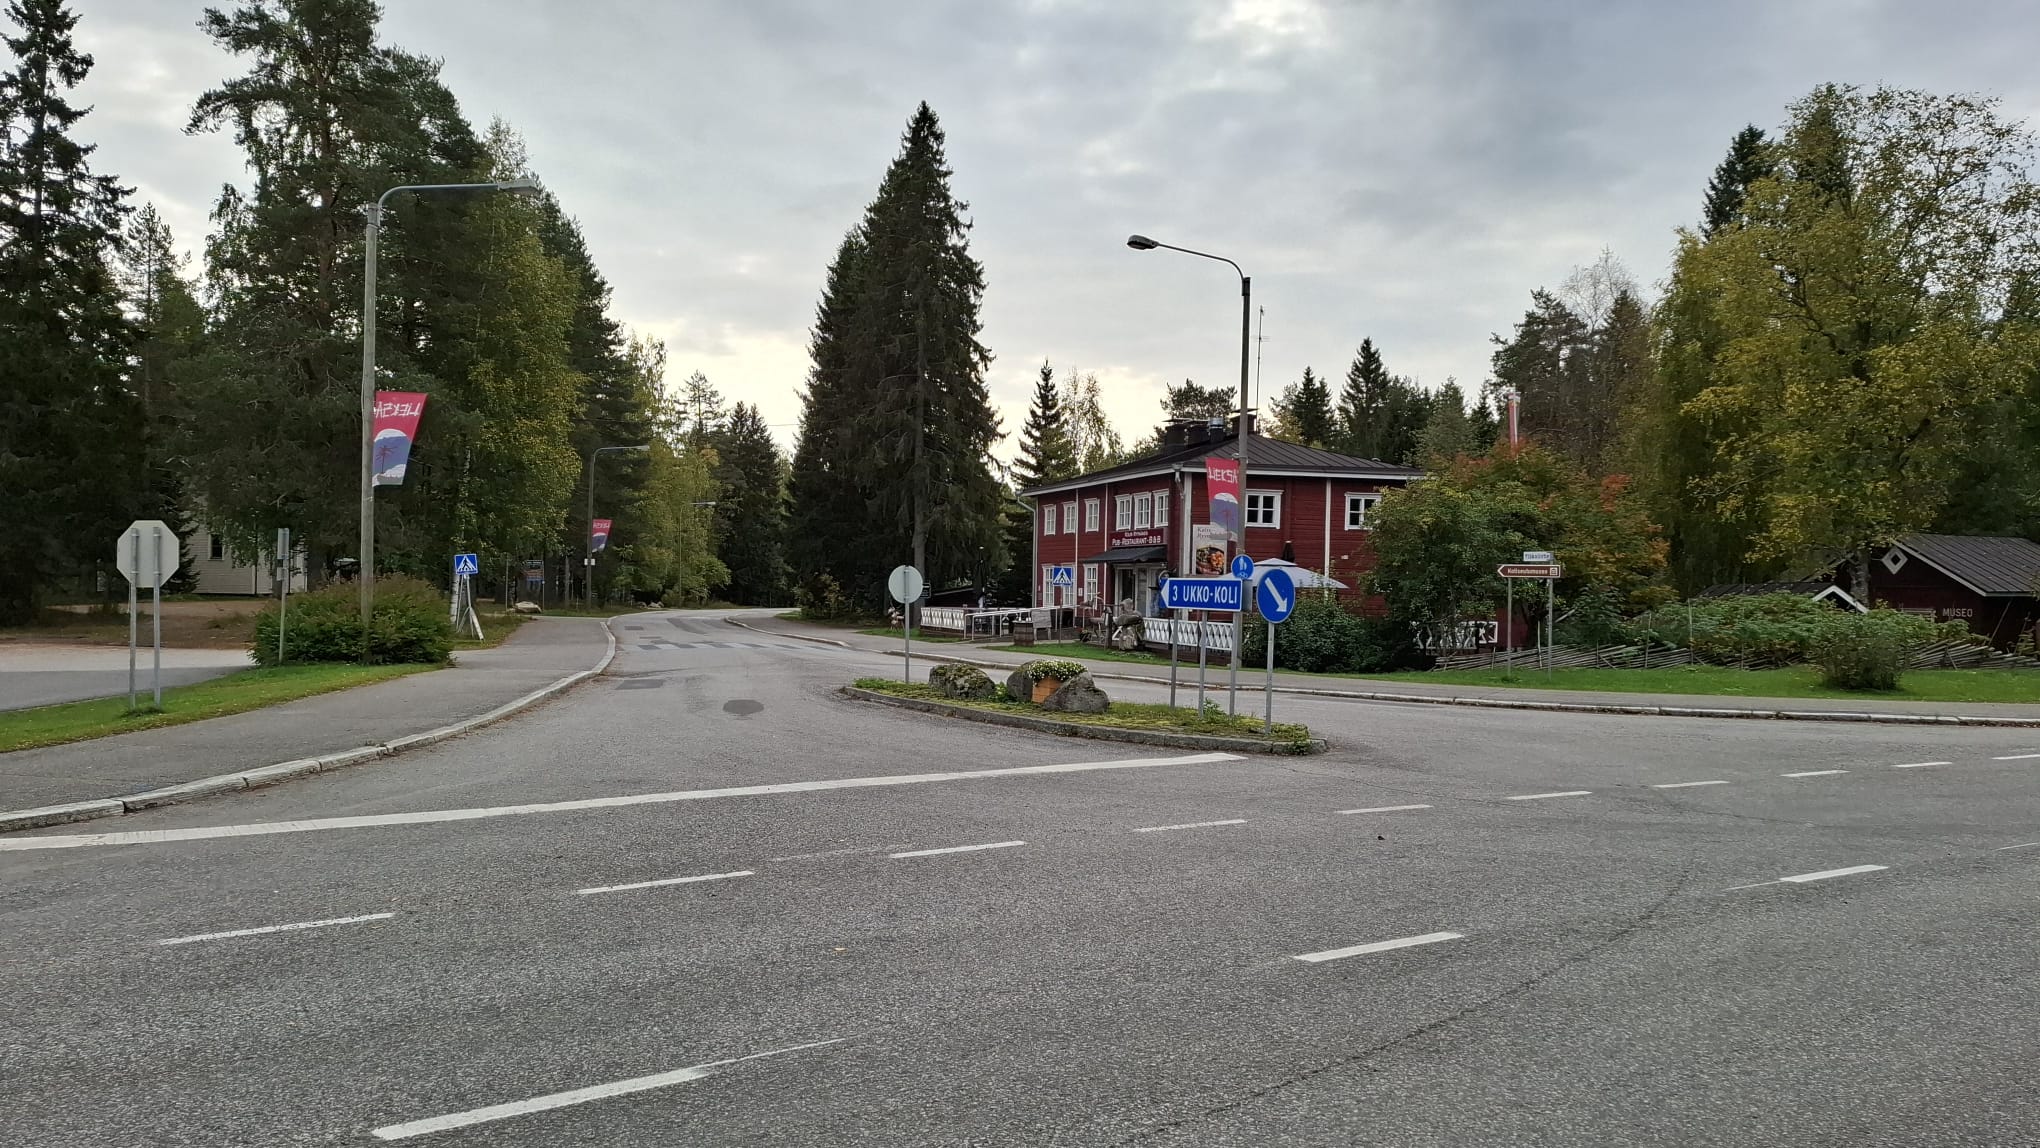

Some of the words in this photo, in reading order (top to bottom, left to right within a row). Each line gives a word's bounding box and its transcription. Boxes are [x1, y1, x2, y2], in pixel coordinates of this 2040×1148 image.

[1172, 585, 1178, 601] 3
[1183, 585, 1238, 604] UKKO-KOLI
[1942, 607, 1973, 618] MUSEO
